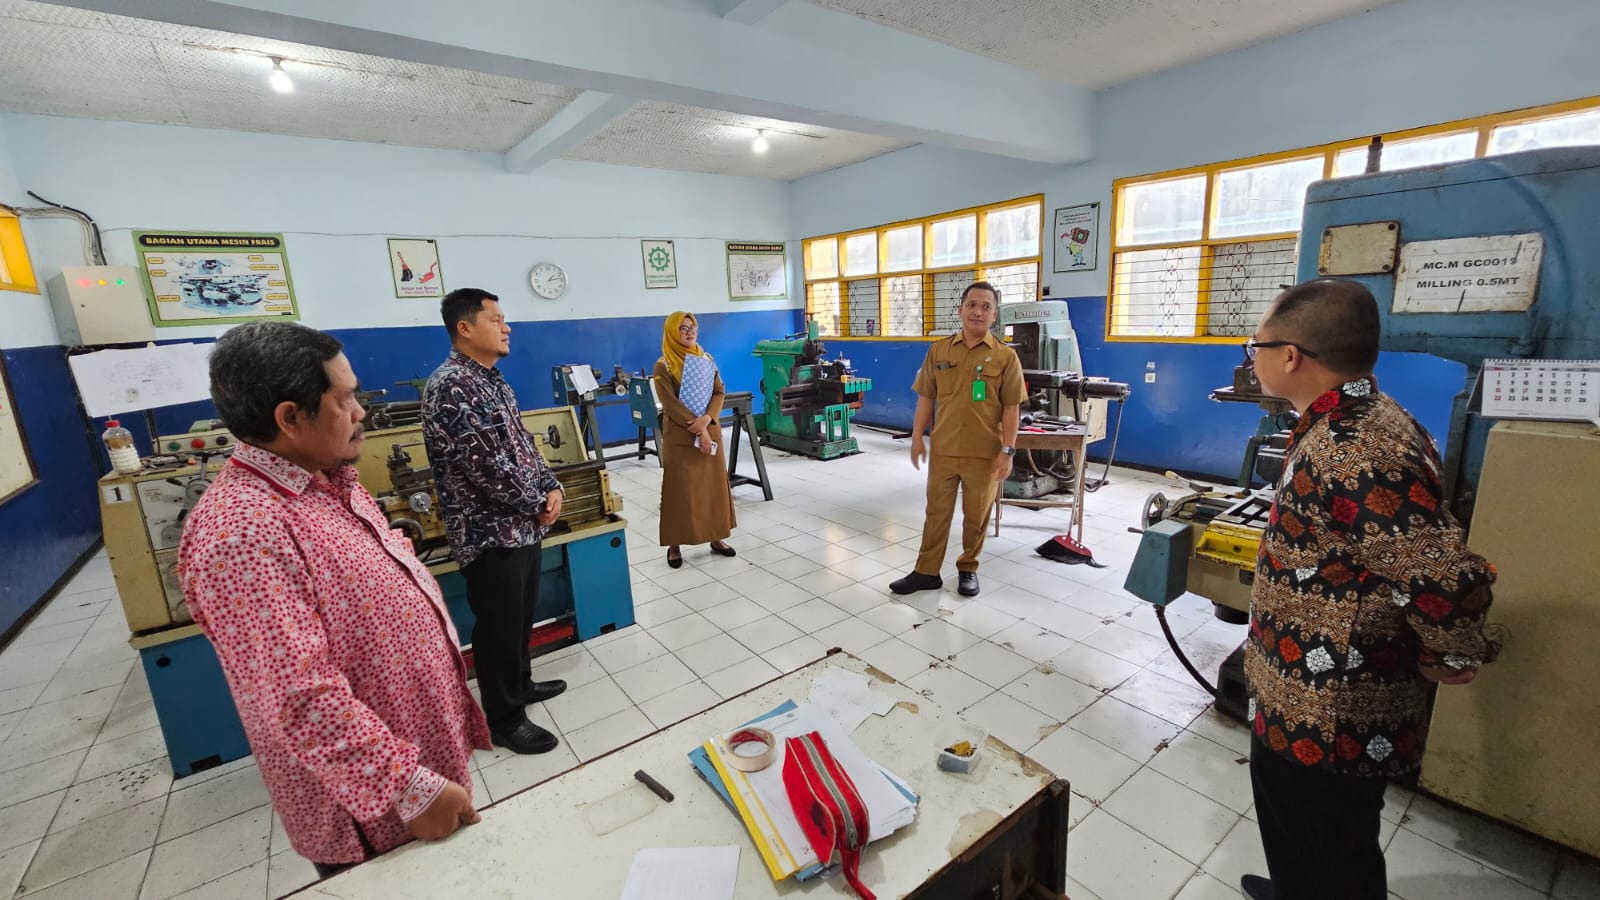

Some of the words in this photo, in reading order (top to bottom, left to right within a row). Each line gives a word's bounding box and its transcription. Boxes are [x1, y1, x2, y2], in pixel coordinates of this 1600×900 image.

[1423, 260, 1458, 270] MC.M
[1416, 279, 1472, 289] MILLING
[1476, 277, 1520, 286] 0.5MT
[112, 486, 122, 502] 1
